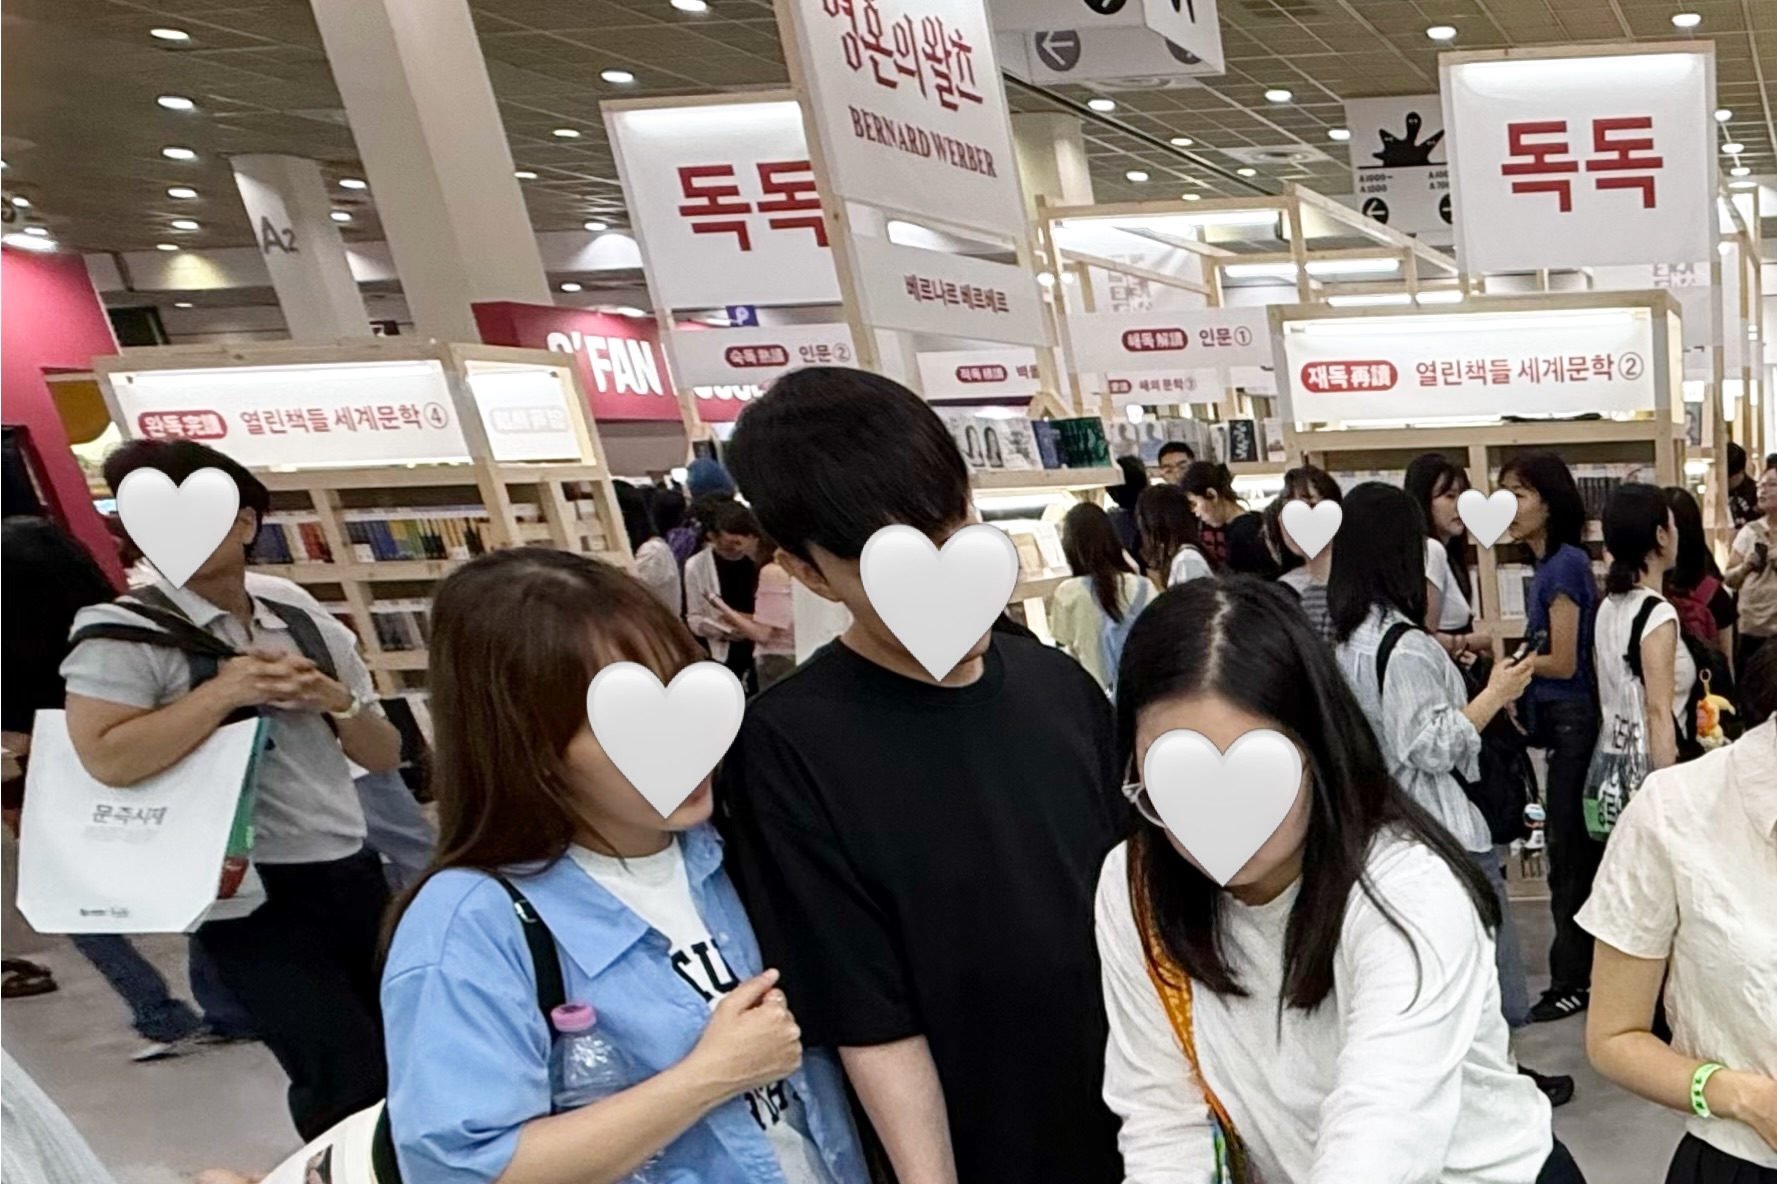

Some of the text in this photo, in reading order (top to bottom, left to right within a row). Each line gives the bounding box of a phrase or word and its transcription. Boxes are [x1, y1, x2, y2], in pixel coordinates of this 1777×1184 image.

[848, 105, 997, 178] BERNARD WERBER
[1501, 116, 1663, 213] 독독
[677, 160, 829, 252] 독독
[261, 216, 299, 255] A2
[904, 274, 960, 306] 베르나르
[1308, 365, 1348, 390] 재독
[1415, 359, 1512, 388] 열린책들
[240, 406, 331, 435] 열린책들
